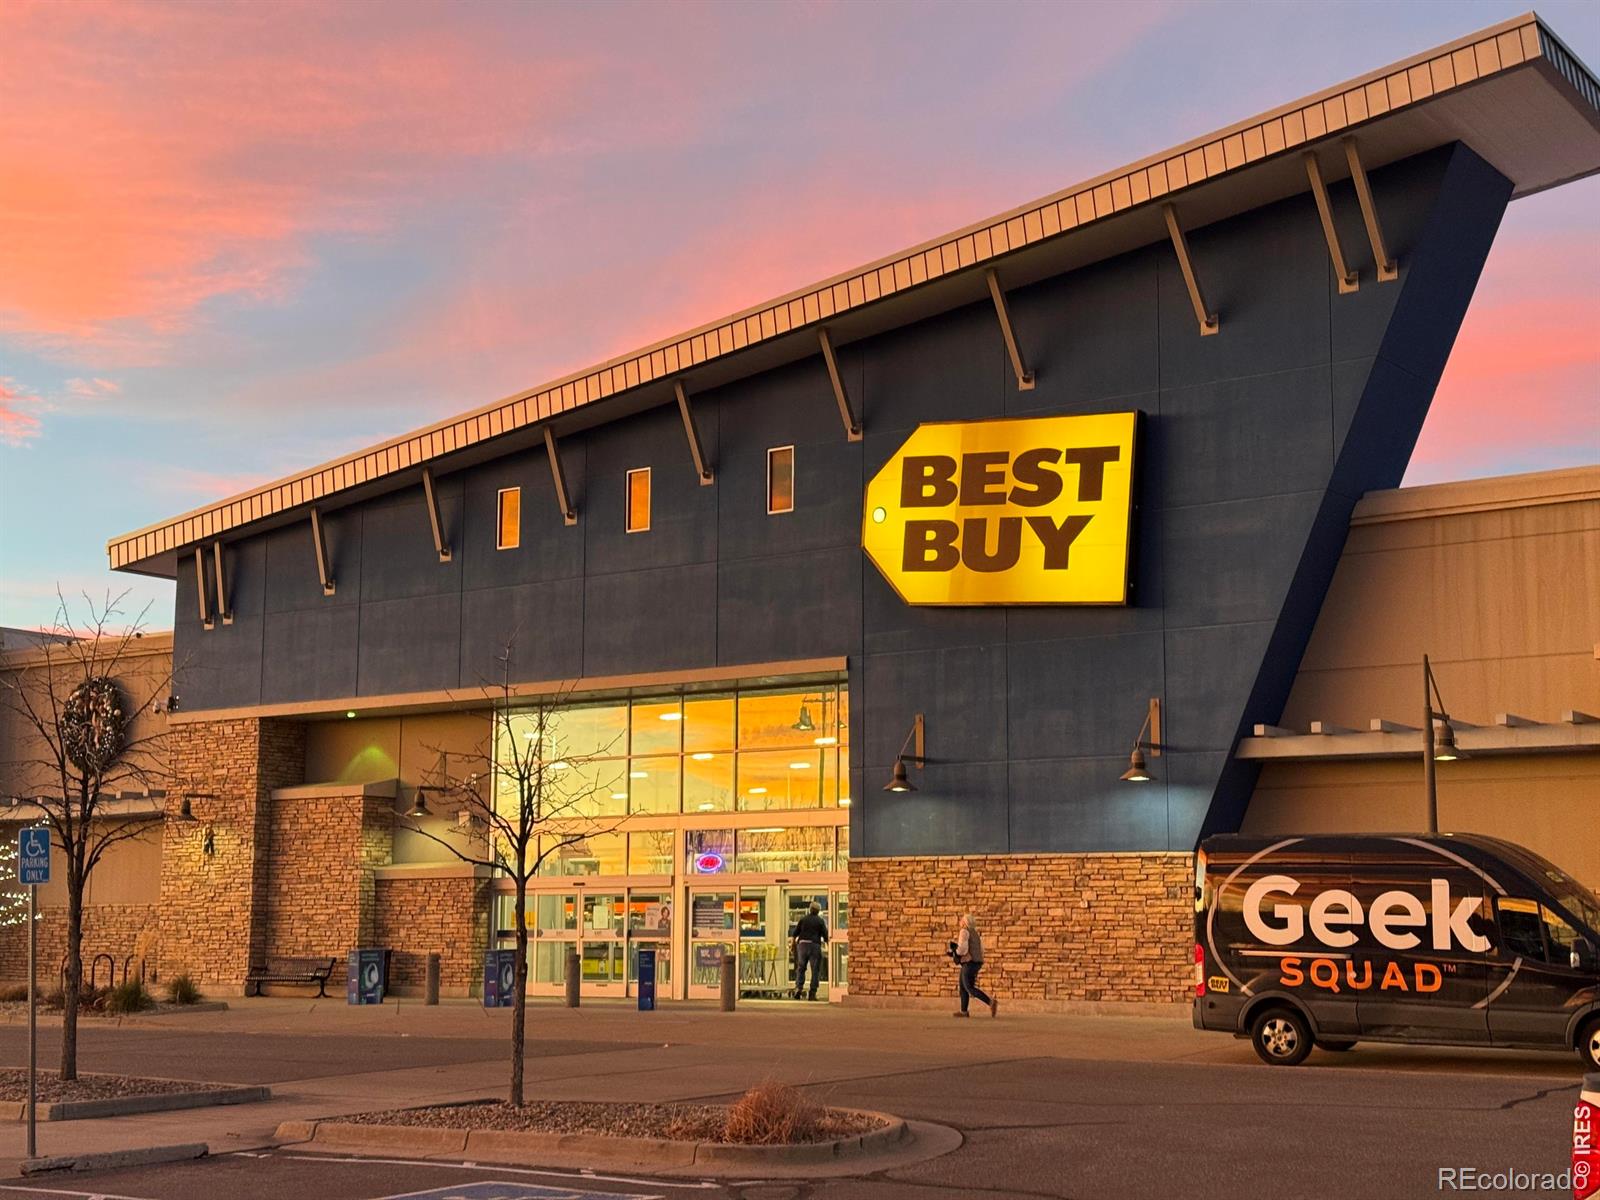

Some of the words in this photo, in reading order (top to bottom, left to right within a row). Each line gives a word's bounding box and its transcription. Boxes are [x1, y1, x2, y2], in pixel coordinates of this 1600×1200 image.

[900, 445, 1120, 508] BEST
[902, 514, 1095, 573] BUY
[21, 857, 49, 868] PARKING
[26, 870, 43, 881] ONLY
[1242, 874, 1492, 953] Geek
[1279, 956, 1442, 993] SQUAD
